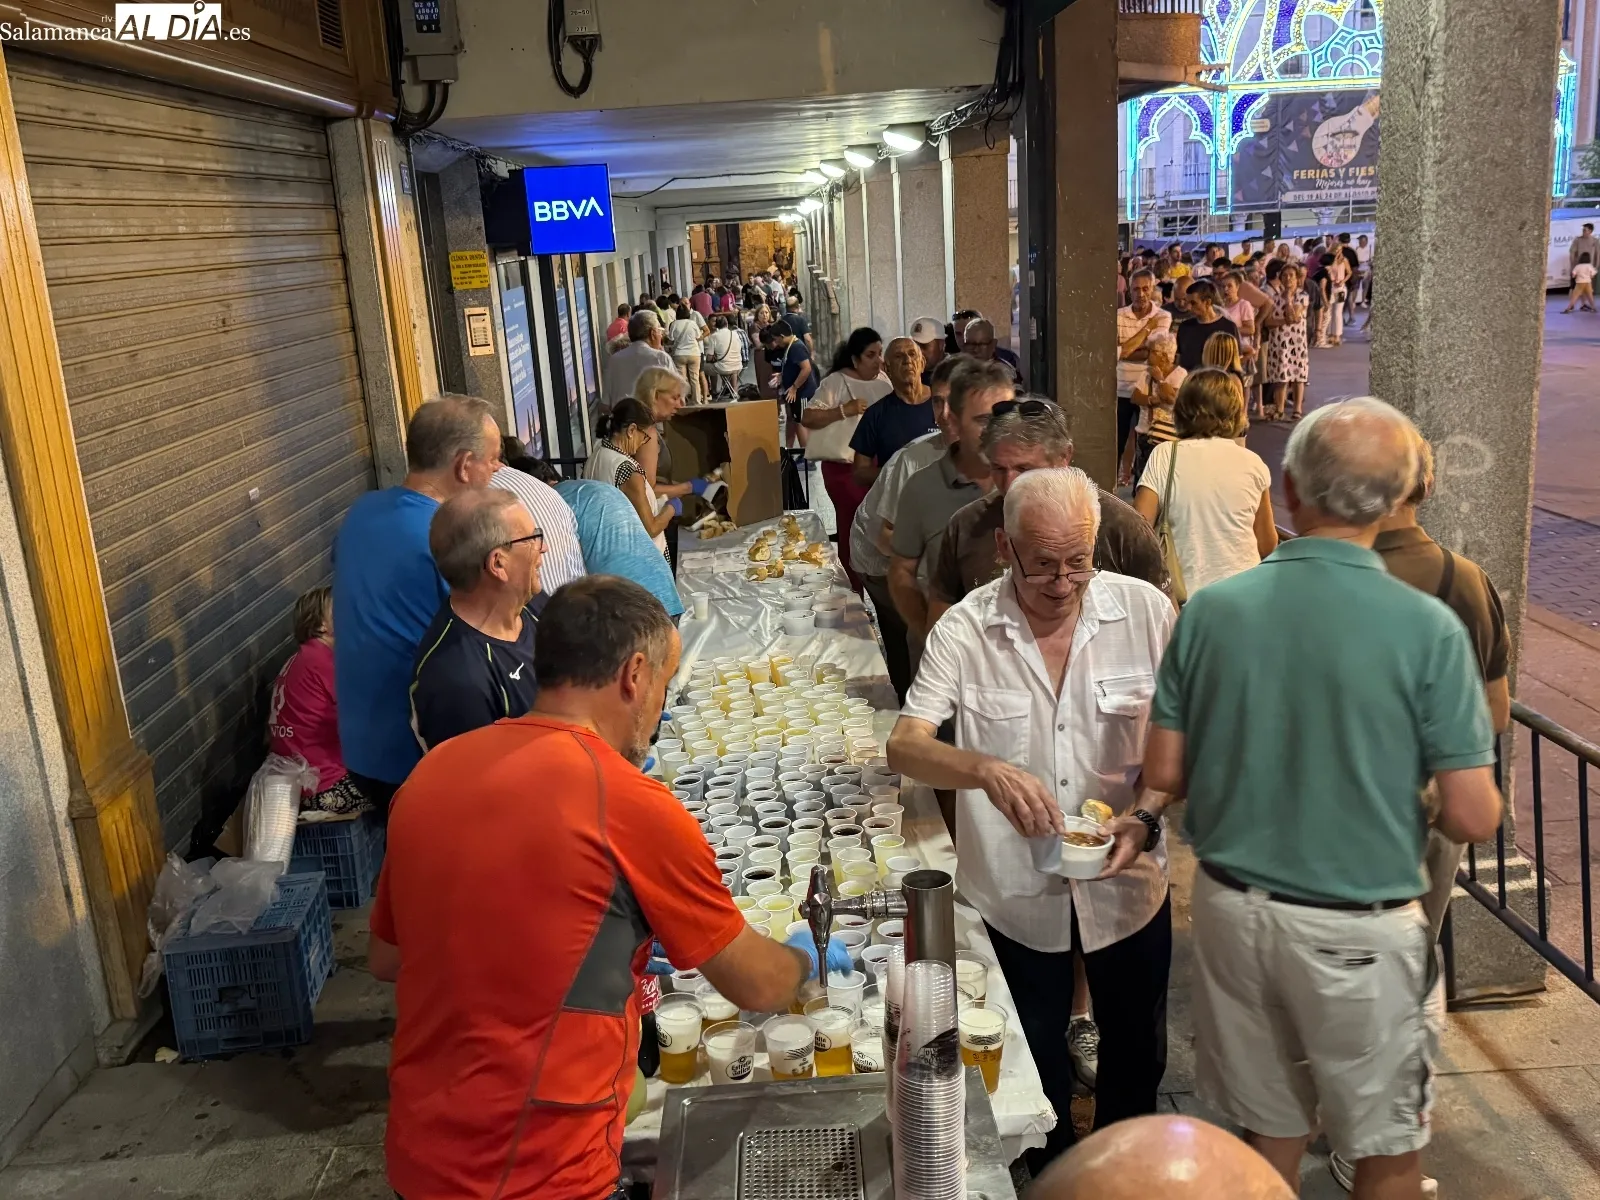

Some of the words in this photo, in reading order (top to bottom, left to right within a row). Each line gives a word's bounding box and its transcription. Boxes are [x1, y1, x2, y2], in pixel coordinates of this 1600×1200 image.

[1293, 168, 1336, 180] FERIAS
[1339, 167, 1346, 178] Y
[1348, 166, 1378, 177] FIES
[533, 196, 605, 222] BBVA
